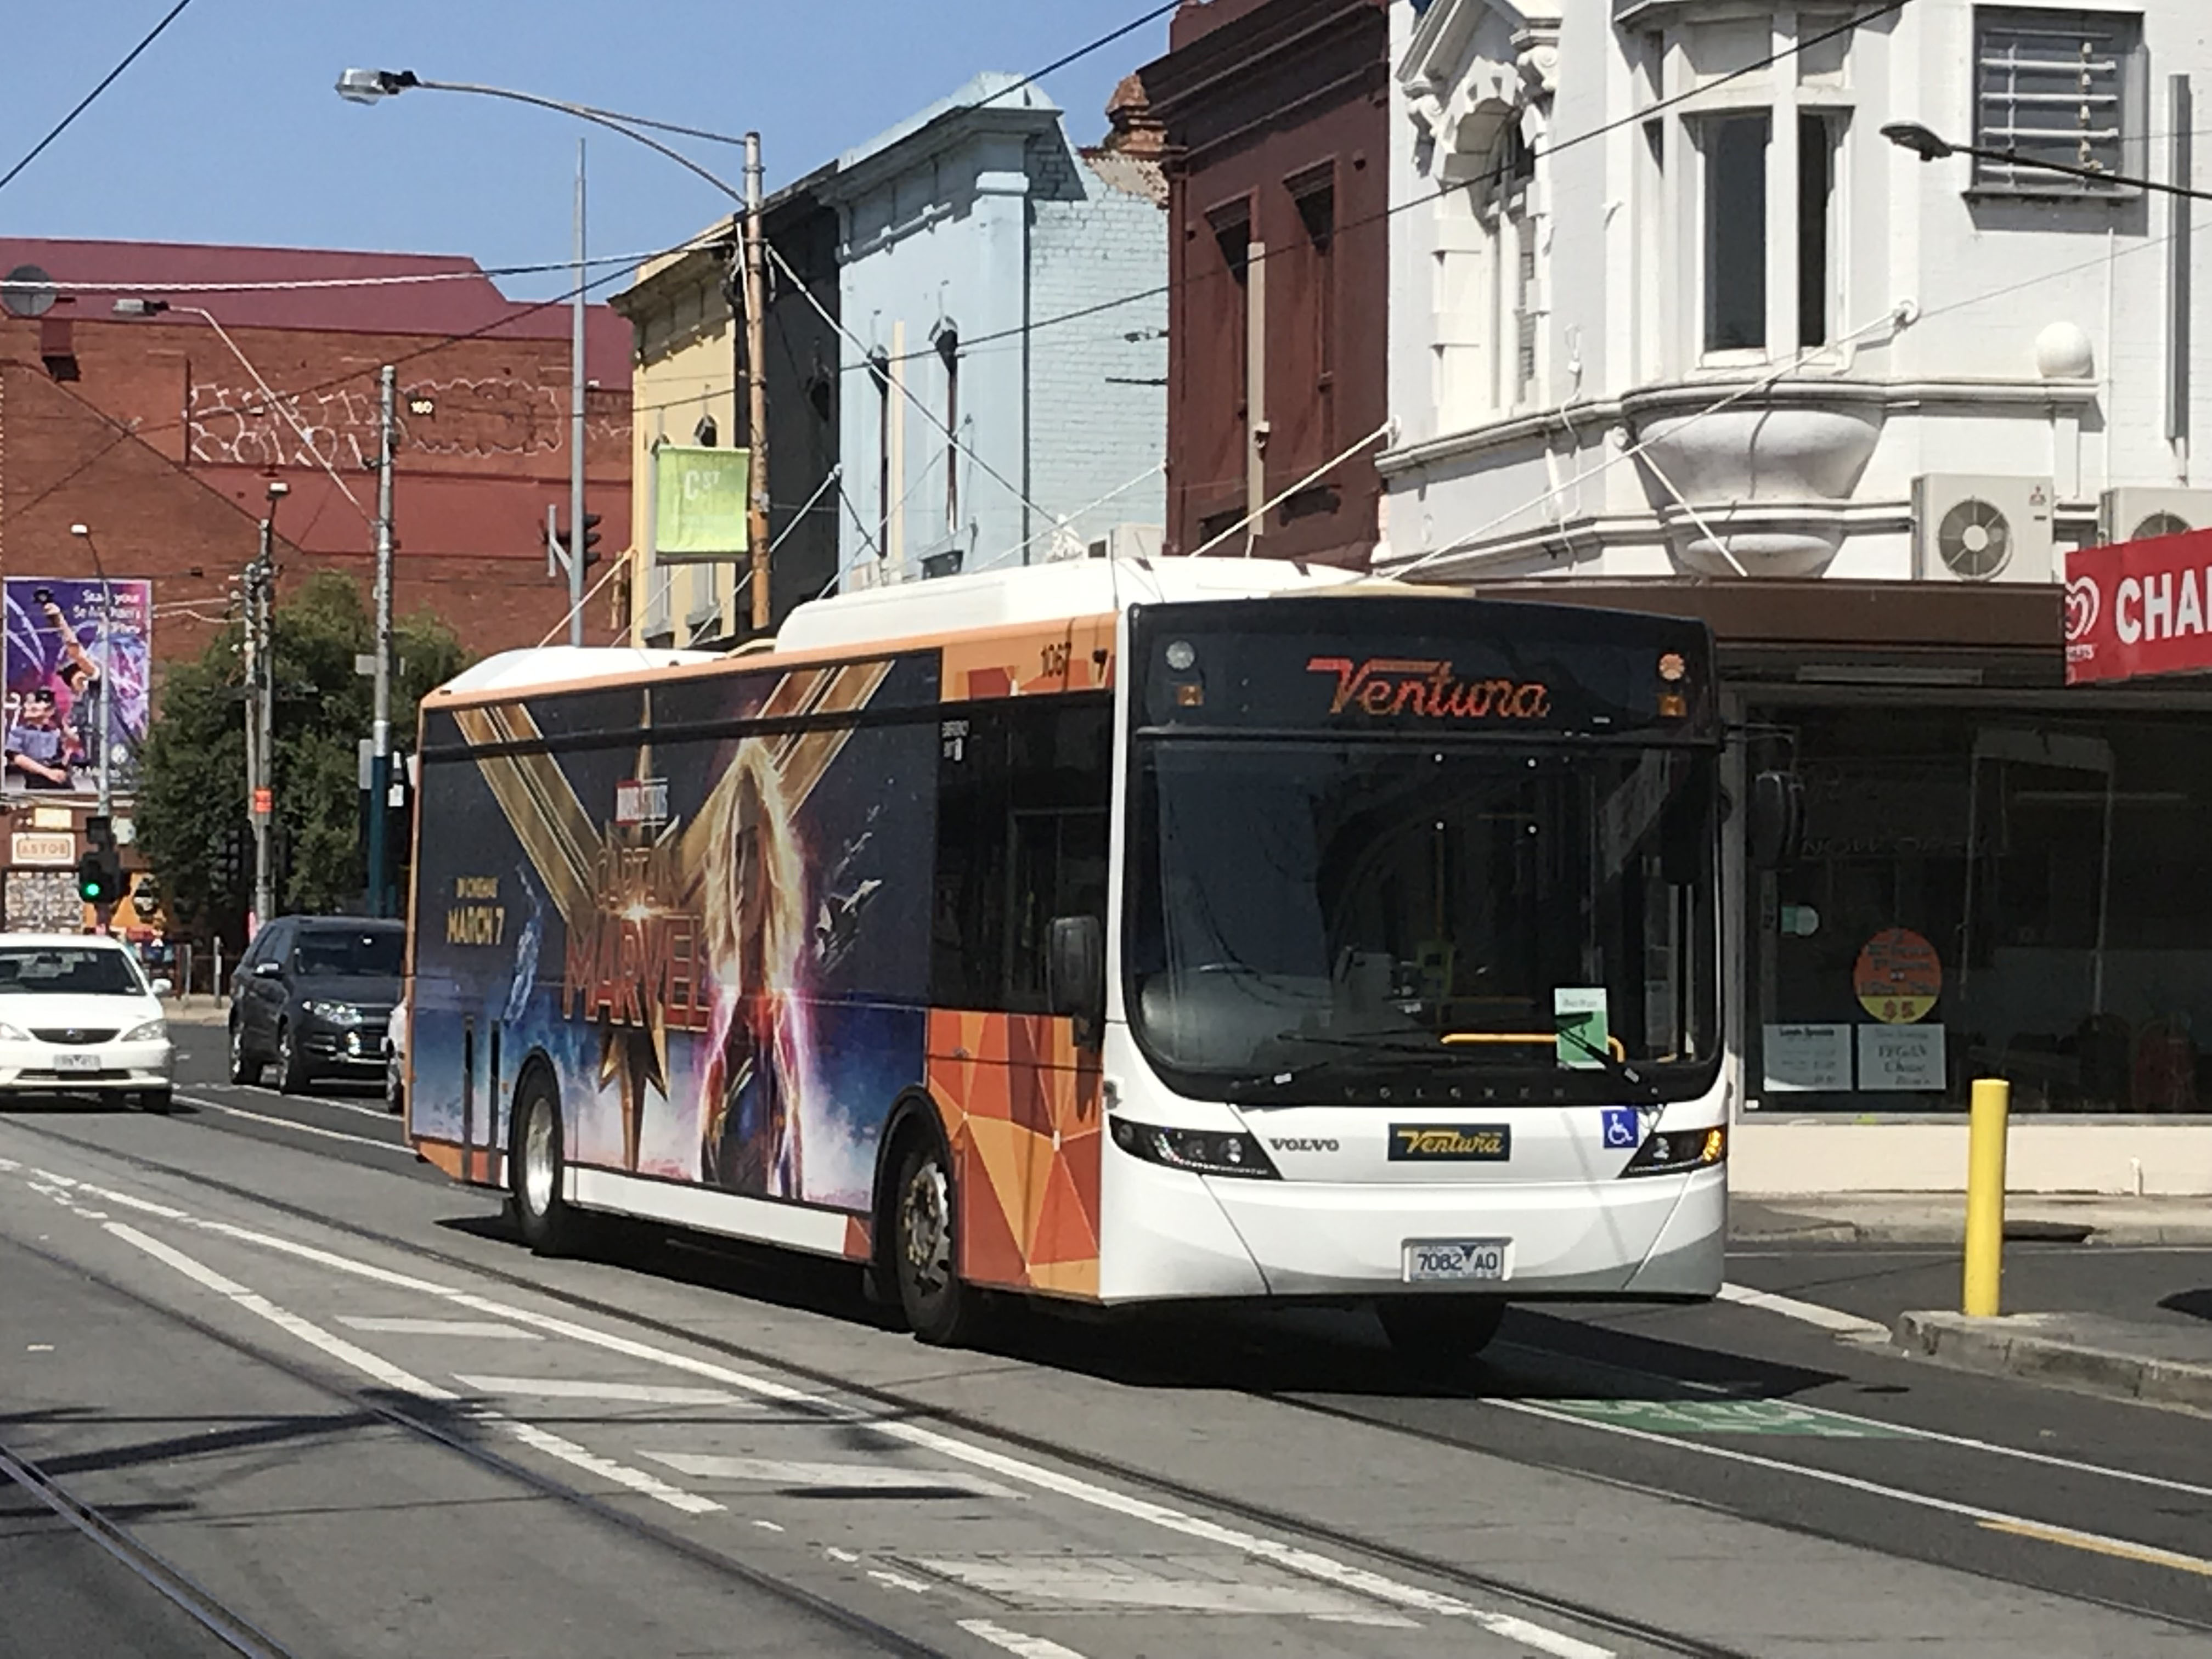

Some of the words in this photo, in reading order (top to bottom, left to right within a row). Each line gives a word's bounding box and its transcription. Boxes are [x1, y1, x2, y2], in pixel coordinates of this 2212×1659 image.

[1306, 658, 1551, 718] Ventura
[447, 906, 493, 944] MARCH
[496, 907, 505, 945] 7
[563, 913, 711, 1032] MARVEL
[1270, 1138, 1340, 1152] VOLVO
[1397, 1130, 1505, 1154] Ventura
